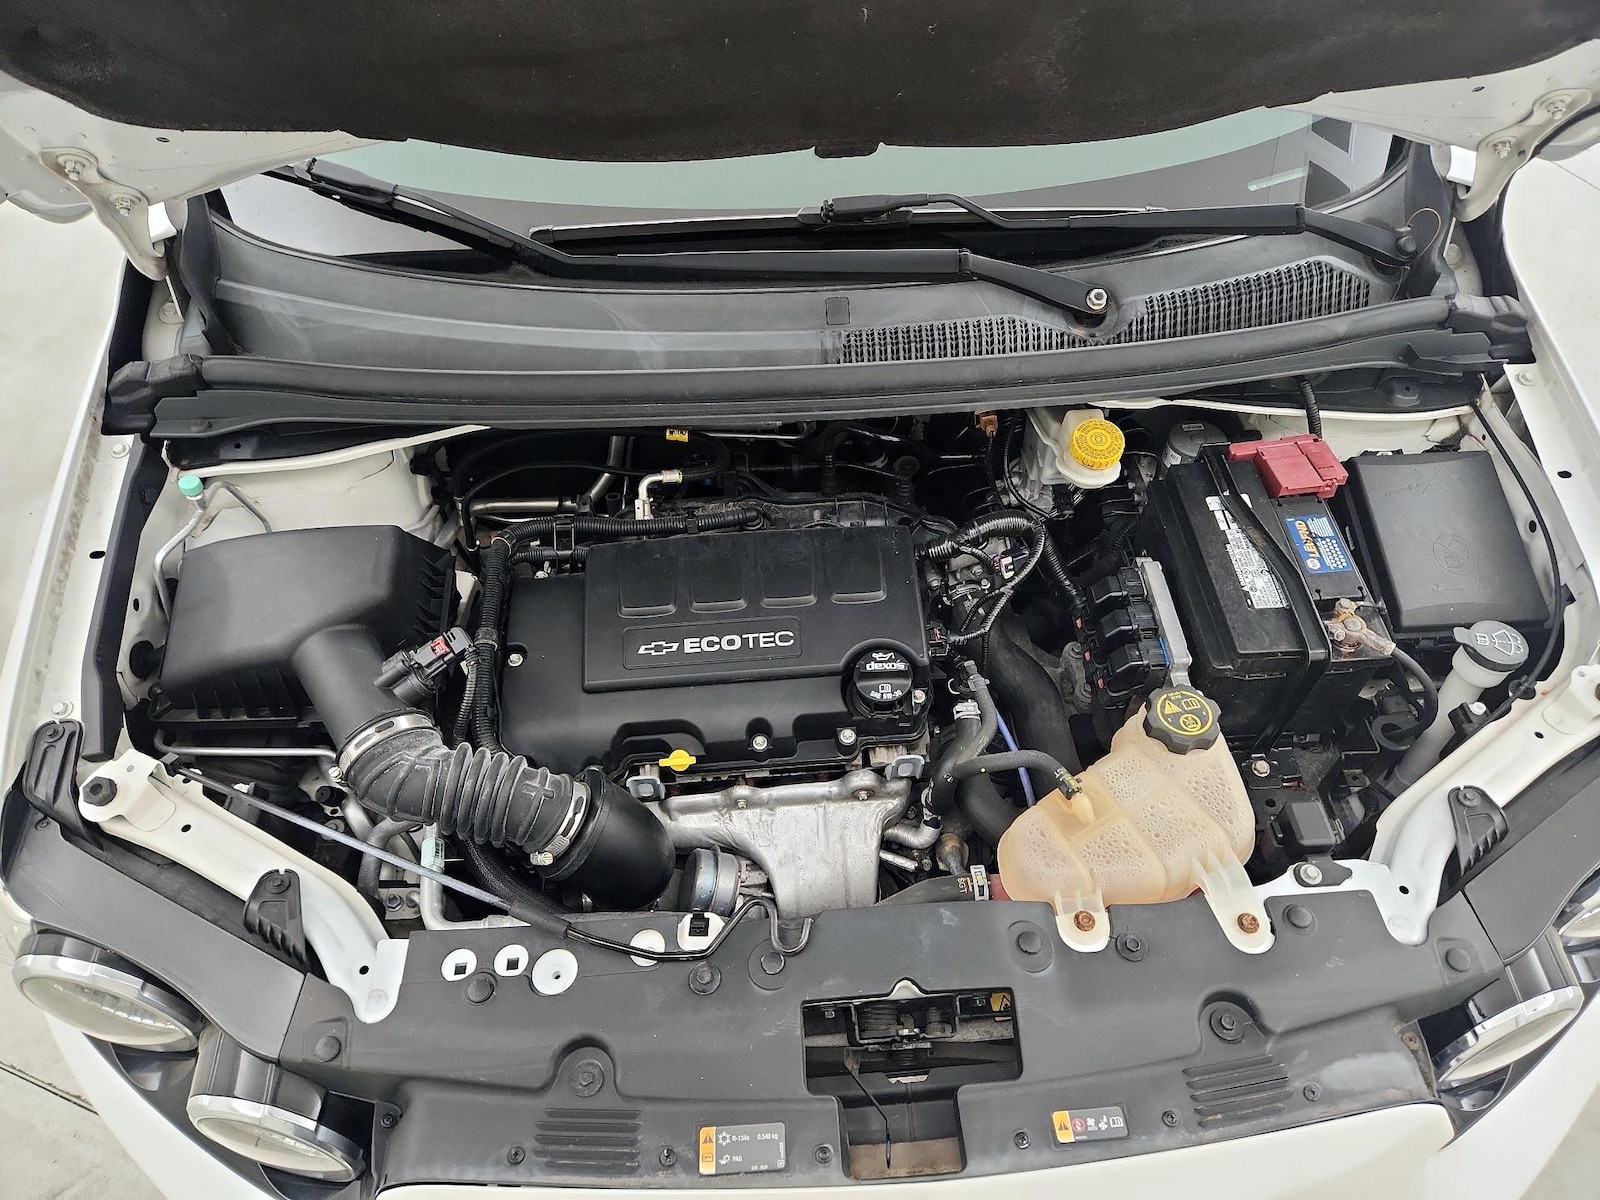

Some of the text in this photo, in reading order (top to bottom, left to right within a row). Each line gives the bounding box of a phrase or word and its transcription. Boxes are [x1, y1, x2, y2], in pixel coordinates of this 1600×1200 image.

[683, 630, 795, 654] ECOTEC
[957, 877, 968, 893] SGT
[731, 1134, 750, 1142] R-134a
[732, 1155, 743, 1163] PAG
